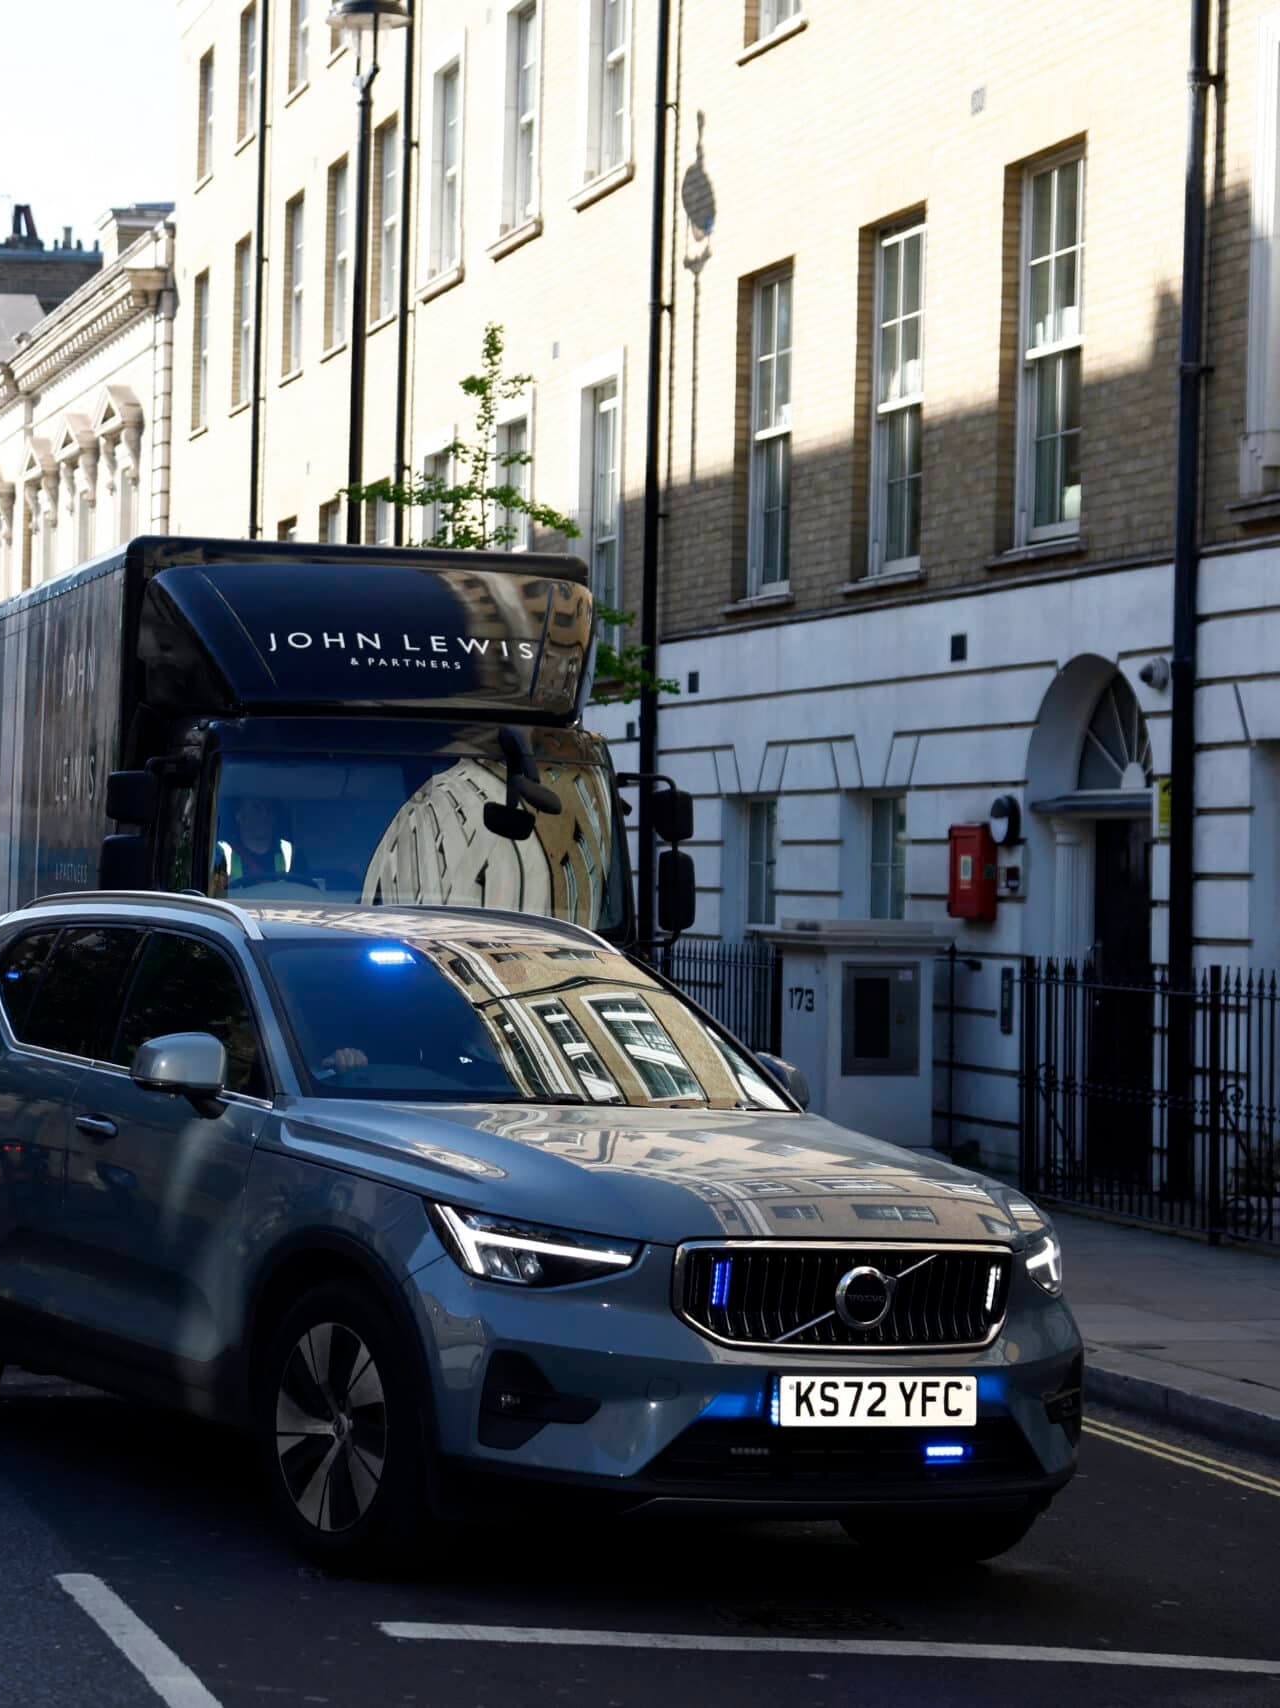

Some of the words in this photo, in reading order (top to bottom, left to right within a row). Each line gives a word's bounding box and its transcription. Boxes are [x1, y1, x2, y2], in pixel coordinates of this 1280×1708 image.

[269, 632, 381, 652] JOHN
[403, 633, 535, 660] LEWIS
[61, 648, 96, 706] JOHN
[350, 656, 361, 666] &
[368, 656, 462, 670] PARTNERS
[55, 755, 95, 803] LEWIS
[788, 987, 815, 1013] 173
[794, 1381, 887, 1418] KS72
[898, 1381, 963, 1418] YFC
